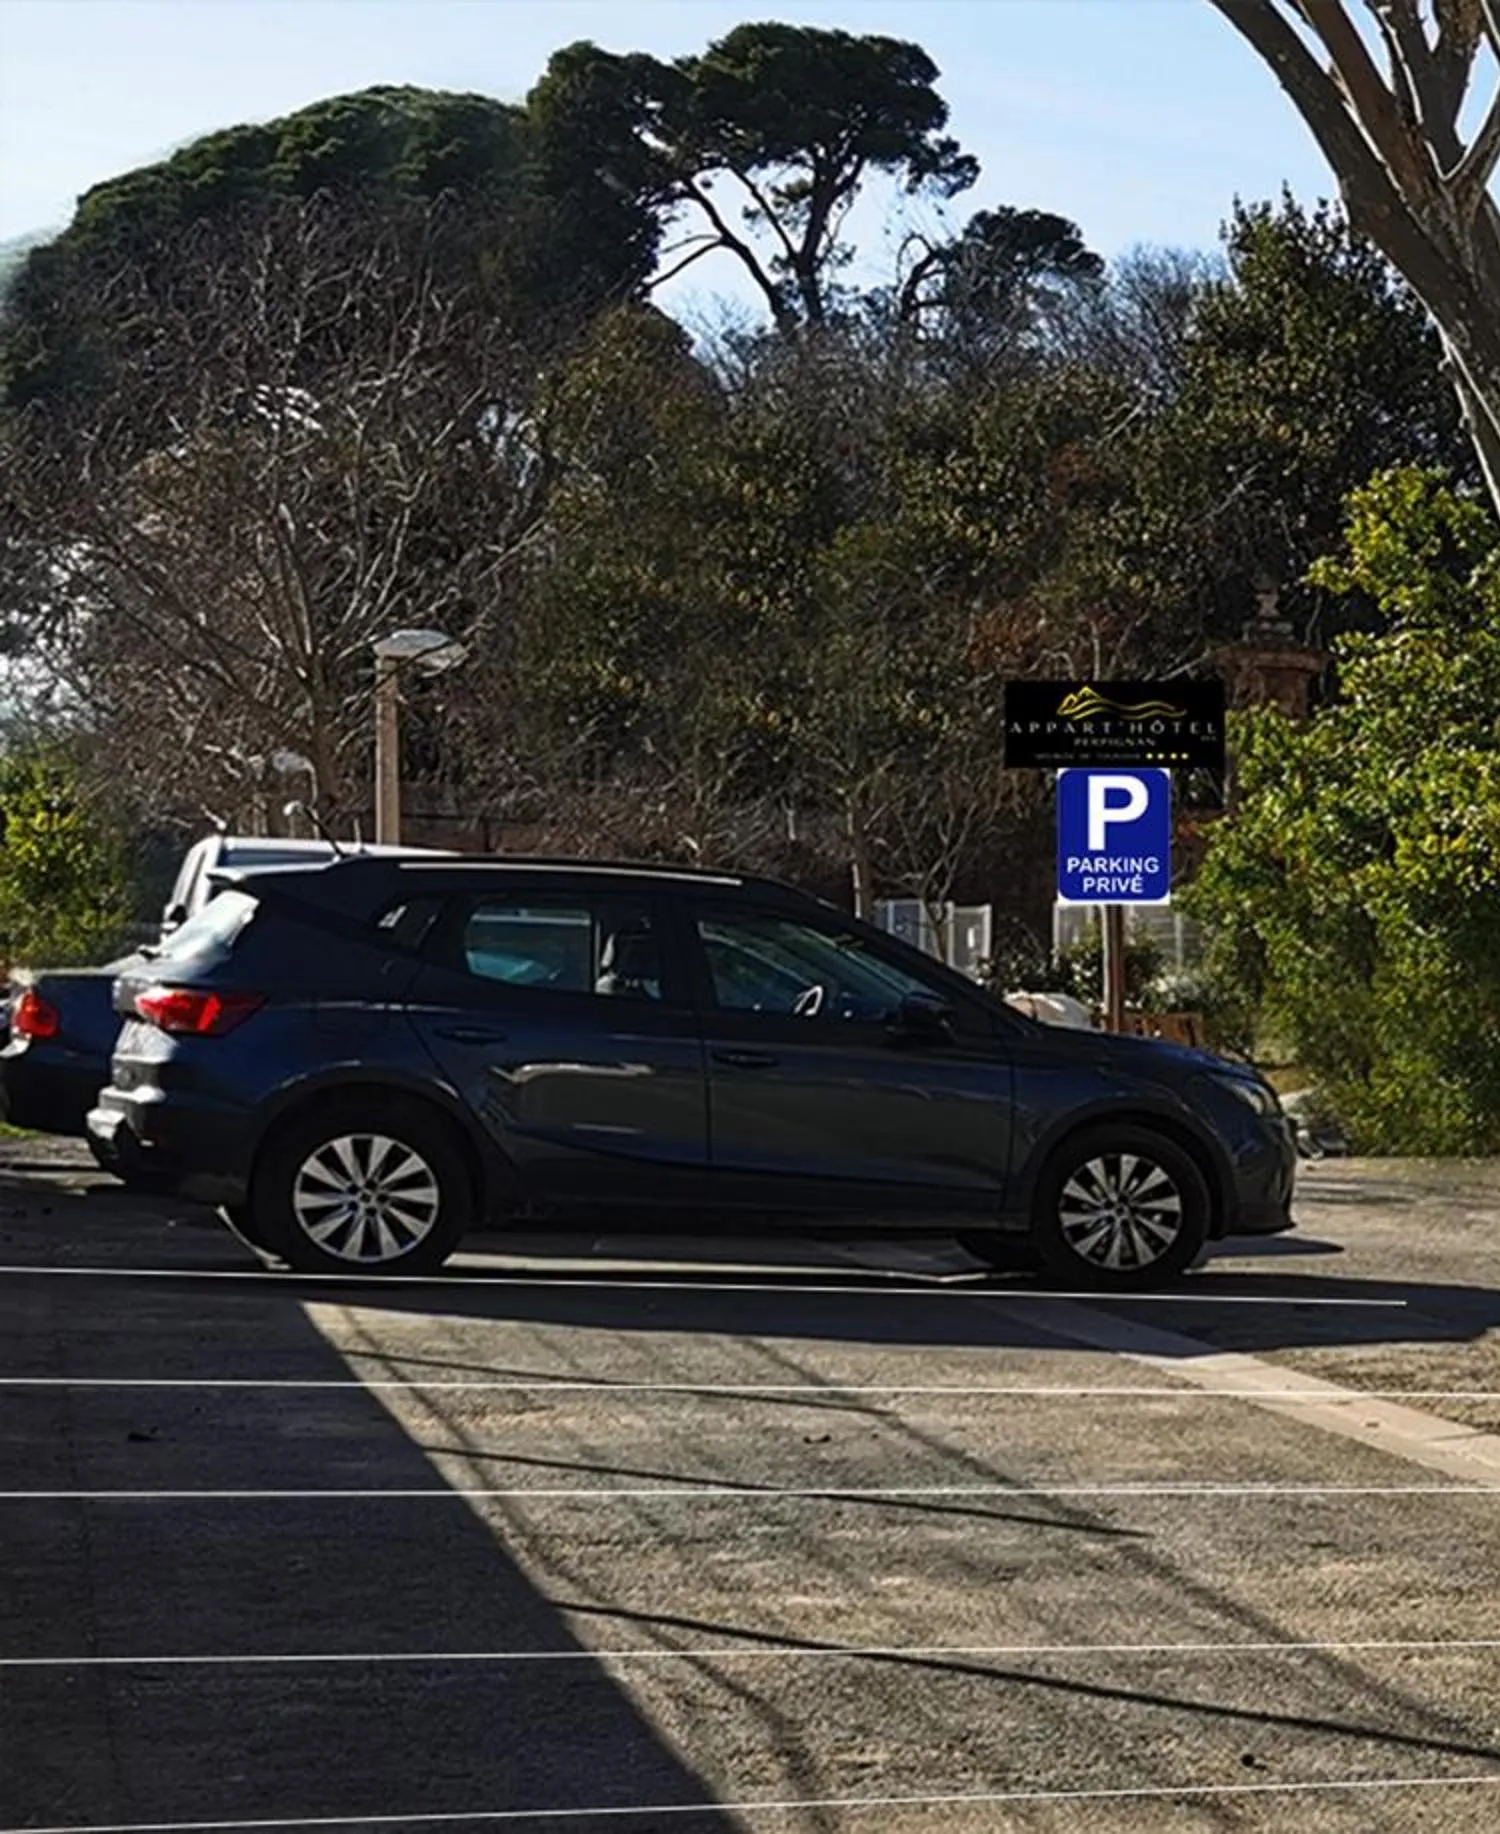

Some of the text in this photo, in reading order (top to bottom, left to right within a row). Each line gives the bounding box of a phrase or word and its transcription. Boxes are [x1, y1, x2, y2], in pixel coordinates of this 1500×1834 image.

[1088, 775, 1149, 851] P
[1067, 857, 1160, 873] PARKING
[1083, 875, 1144, 893] PRIVÉ
